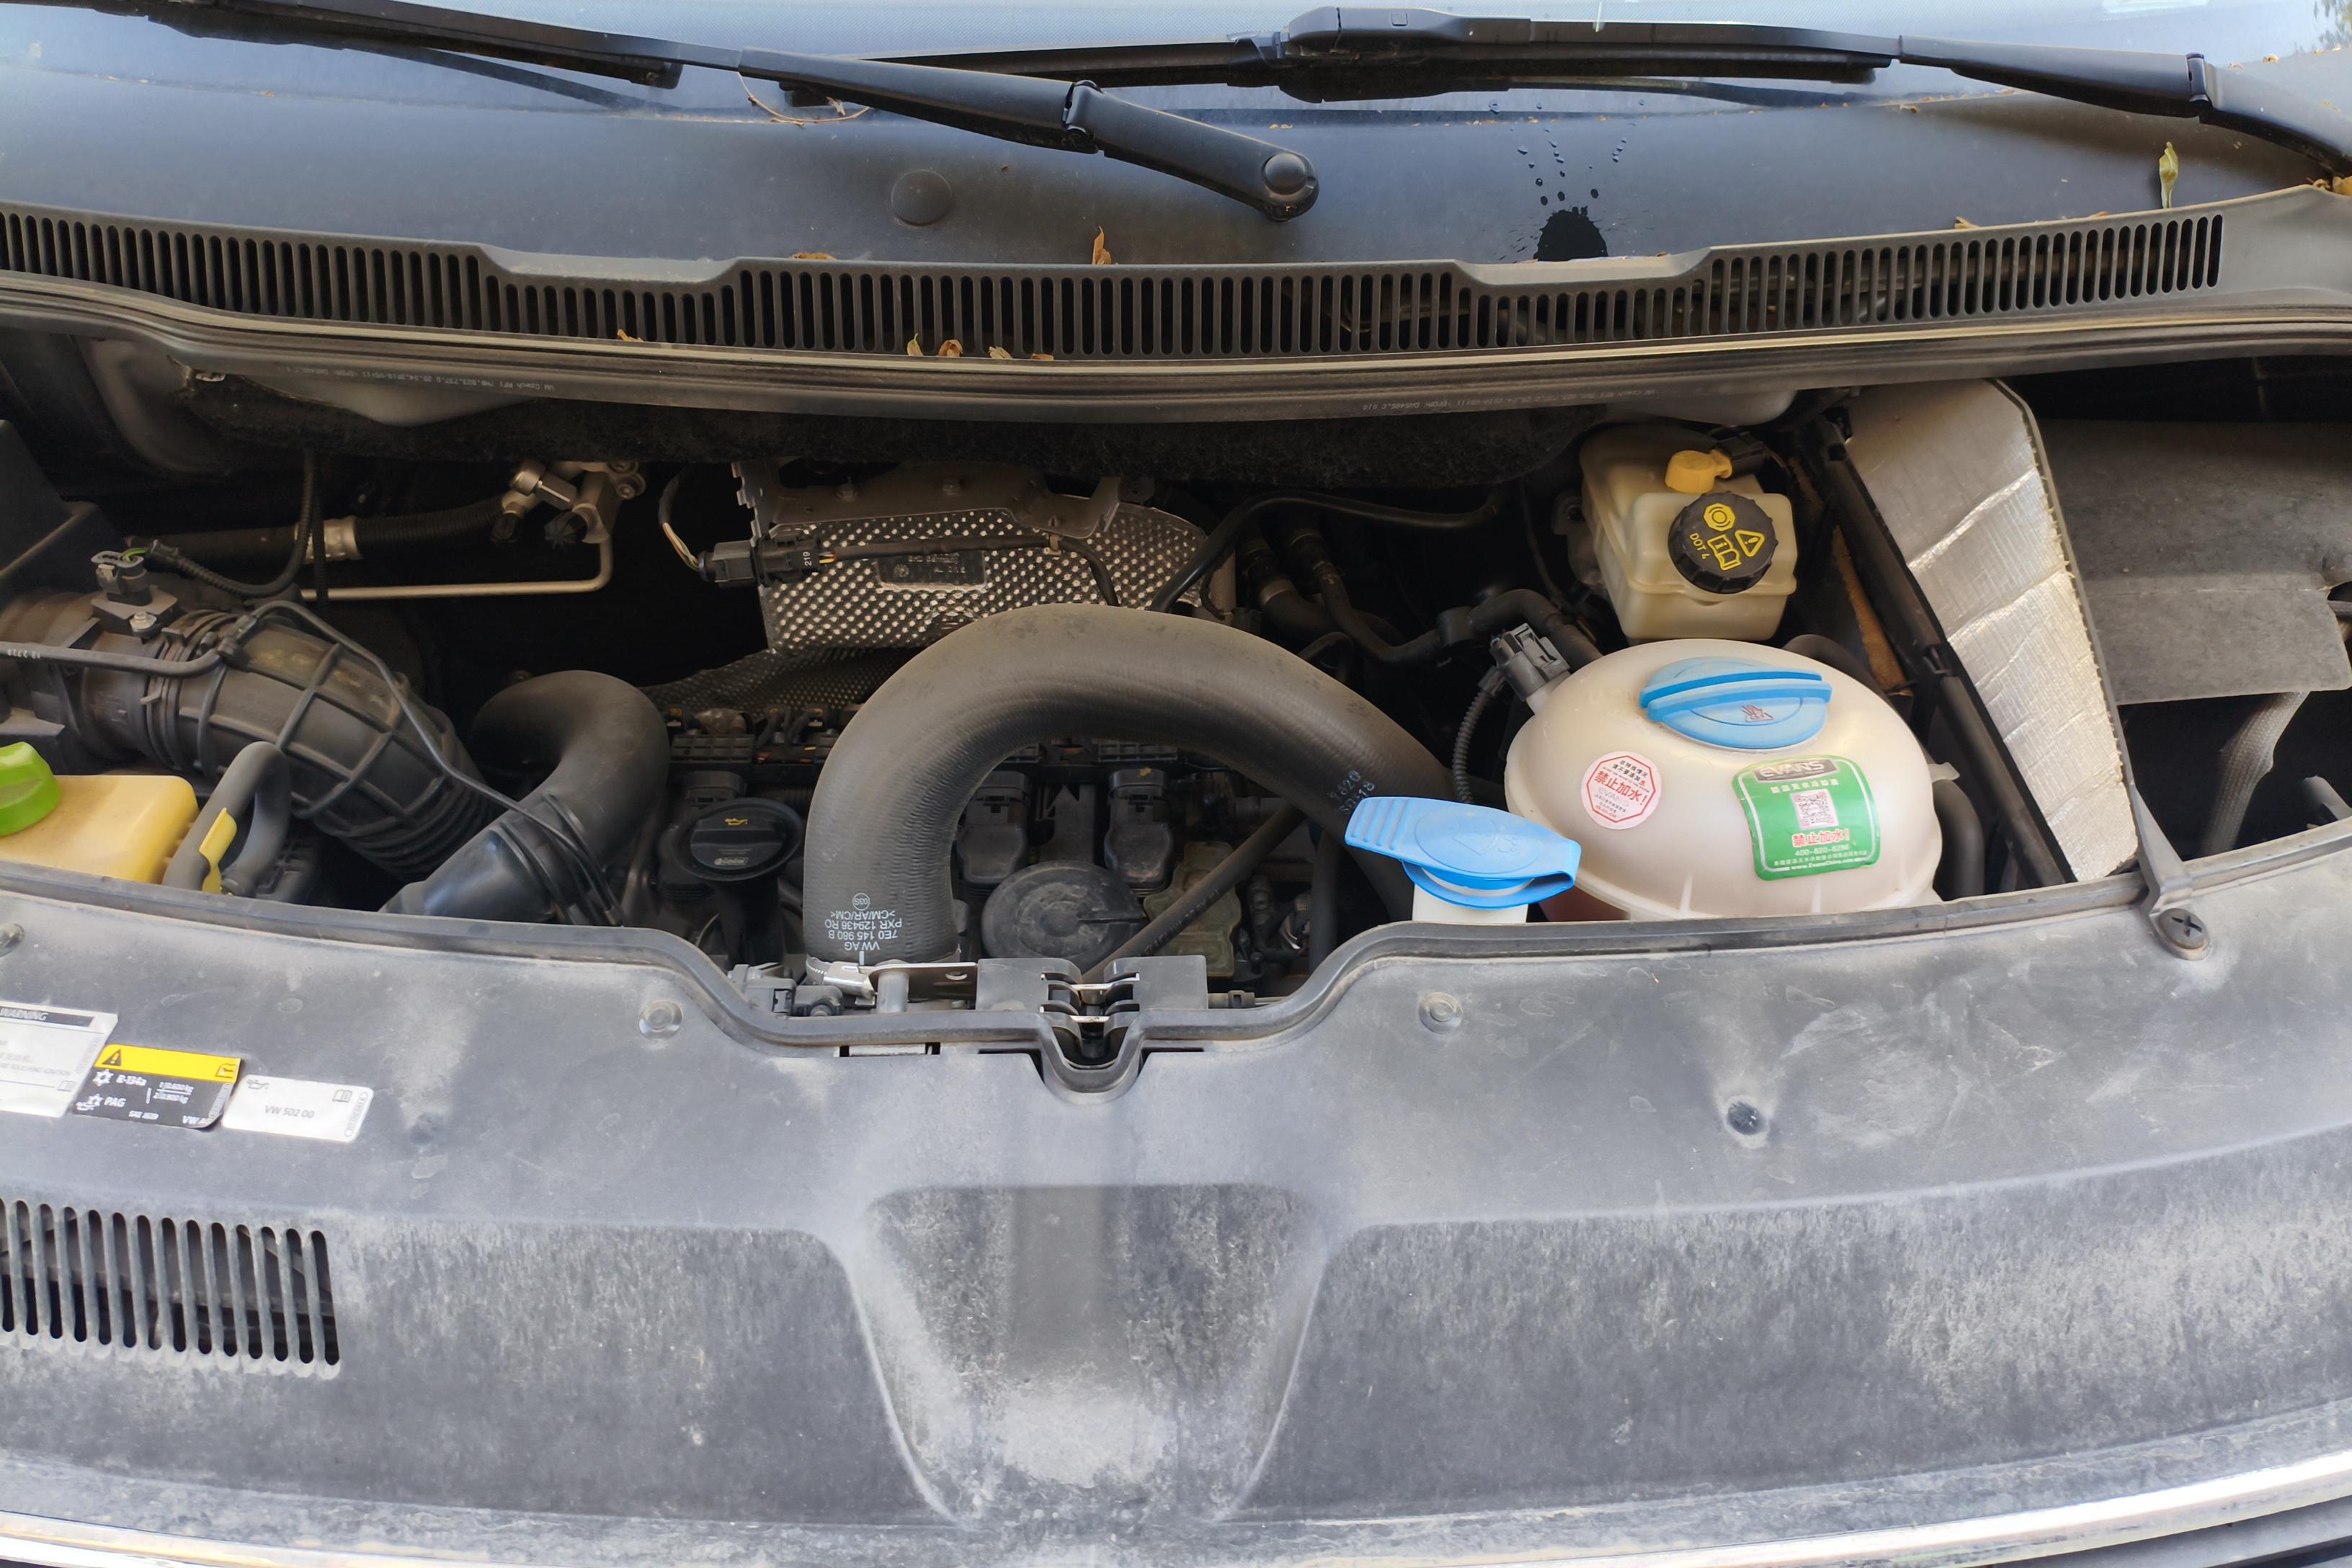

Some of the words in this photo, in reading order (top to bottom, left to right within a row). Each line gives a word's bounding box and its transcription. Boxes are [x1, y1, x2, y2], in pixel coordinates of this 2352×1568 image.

[1690, 533, 1706, 551] DOT
[802, 551, 812, 567] 219
[1758, 760, 1825, 778] EVANS
[841, 920, 877, 930] 129436
[879, 918, 903, 930] PXR
[828, 930, 835, 938] B
[837, 930, 855, 940] 980
[857, 931, 876, 940] 145
[878, 929, 899, 940] 7E0
[845, 941, 860, 950] AG
[861, 941, 880, 950] VW
[104, 1096, 127, 1108] PAG
[264, 1105, 283, 1115] VW
[284, 1107, 300, 1117] 502
[300, 1108, 316, 1118] 00
